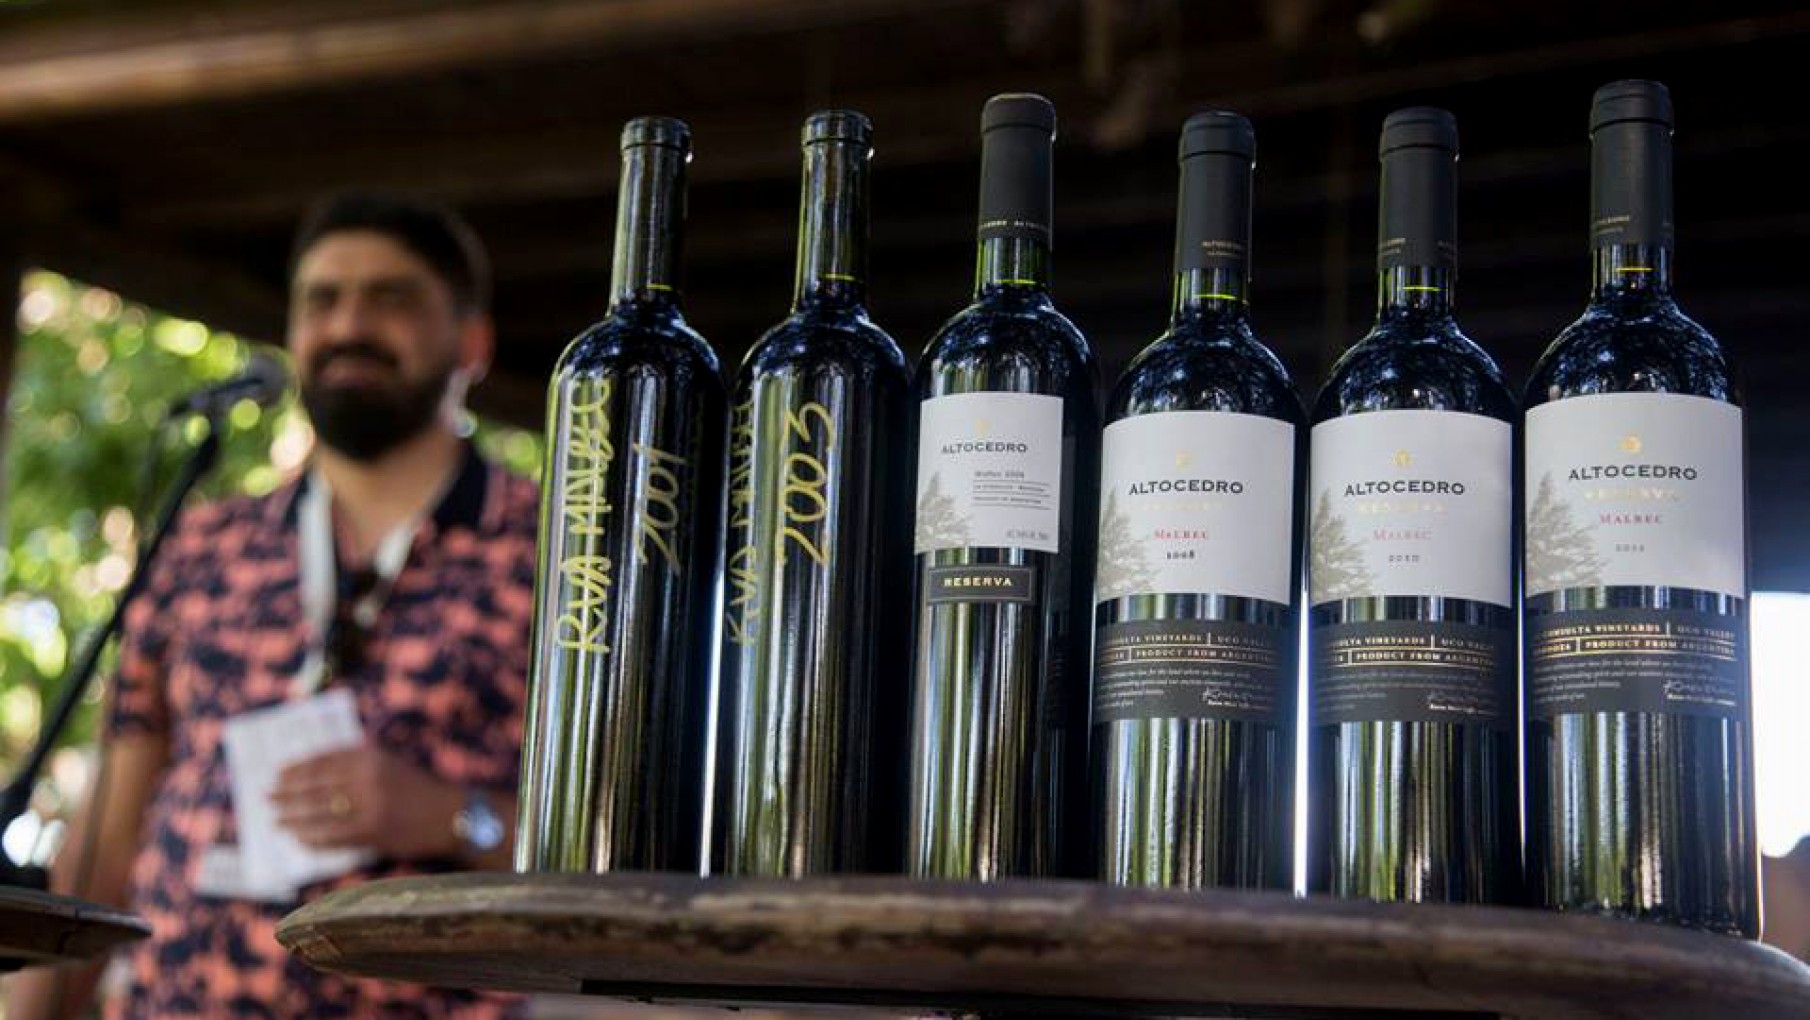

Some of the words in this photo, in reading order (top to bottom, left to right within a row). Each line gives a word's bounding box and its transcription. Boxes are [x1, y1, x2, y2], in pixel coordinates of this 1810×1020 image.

[941, 442, 1028, 454] ALTOCEDRO
[1568, 464, 1698, 482] ALTOCEDRO
[776, 400, 836, 567] 2003
[1129, 479, 1244, 496] ALTOCEDRO
[1344, 480, 1466, 497] ALTOCEDRO
[632, 443, 687, 578] 2001
[1599, 513, 1663, 525] MALBEC
[944, 577, 1013, 587] RESERVA
[1584, 639, 1640, 649] PRODUCT
[1645, 639, 1678, 649] FROM
